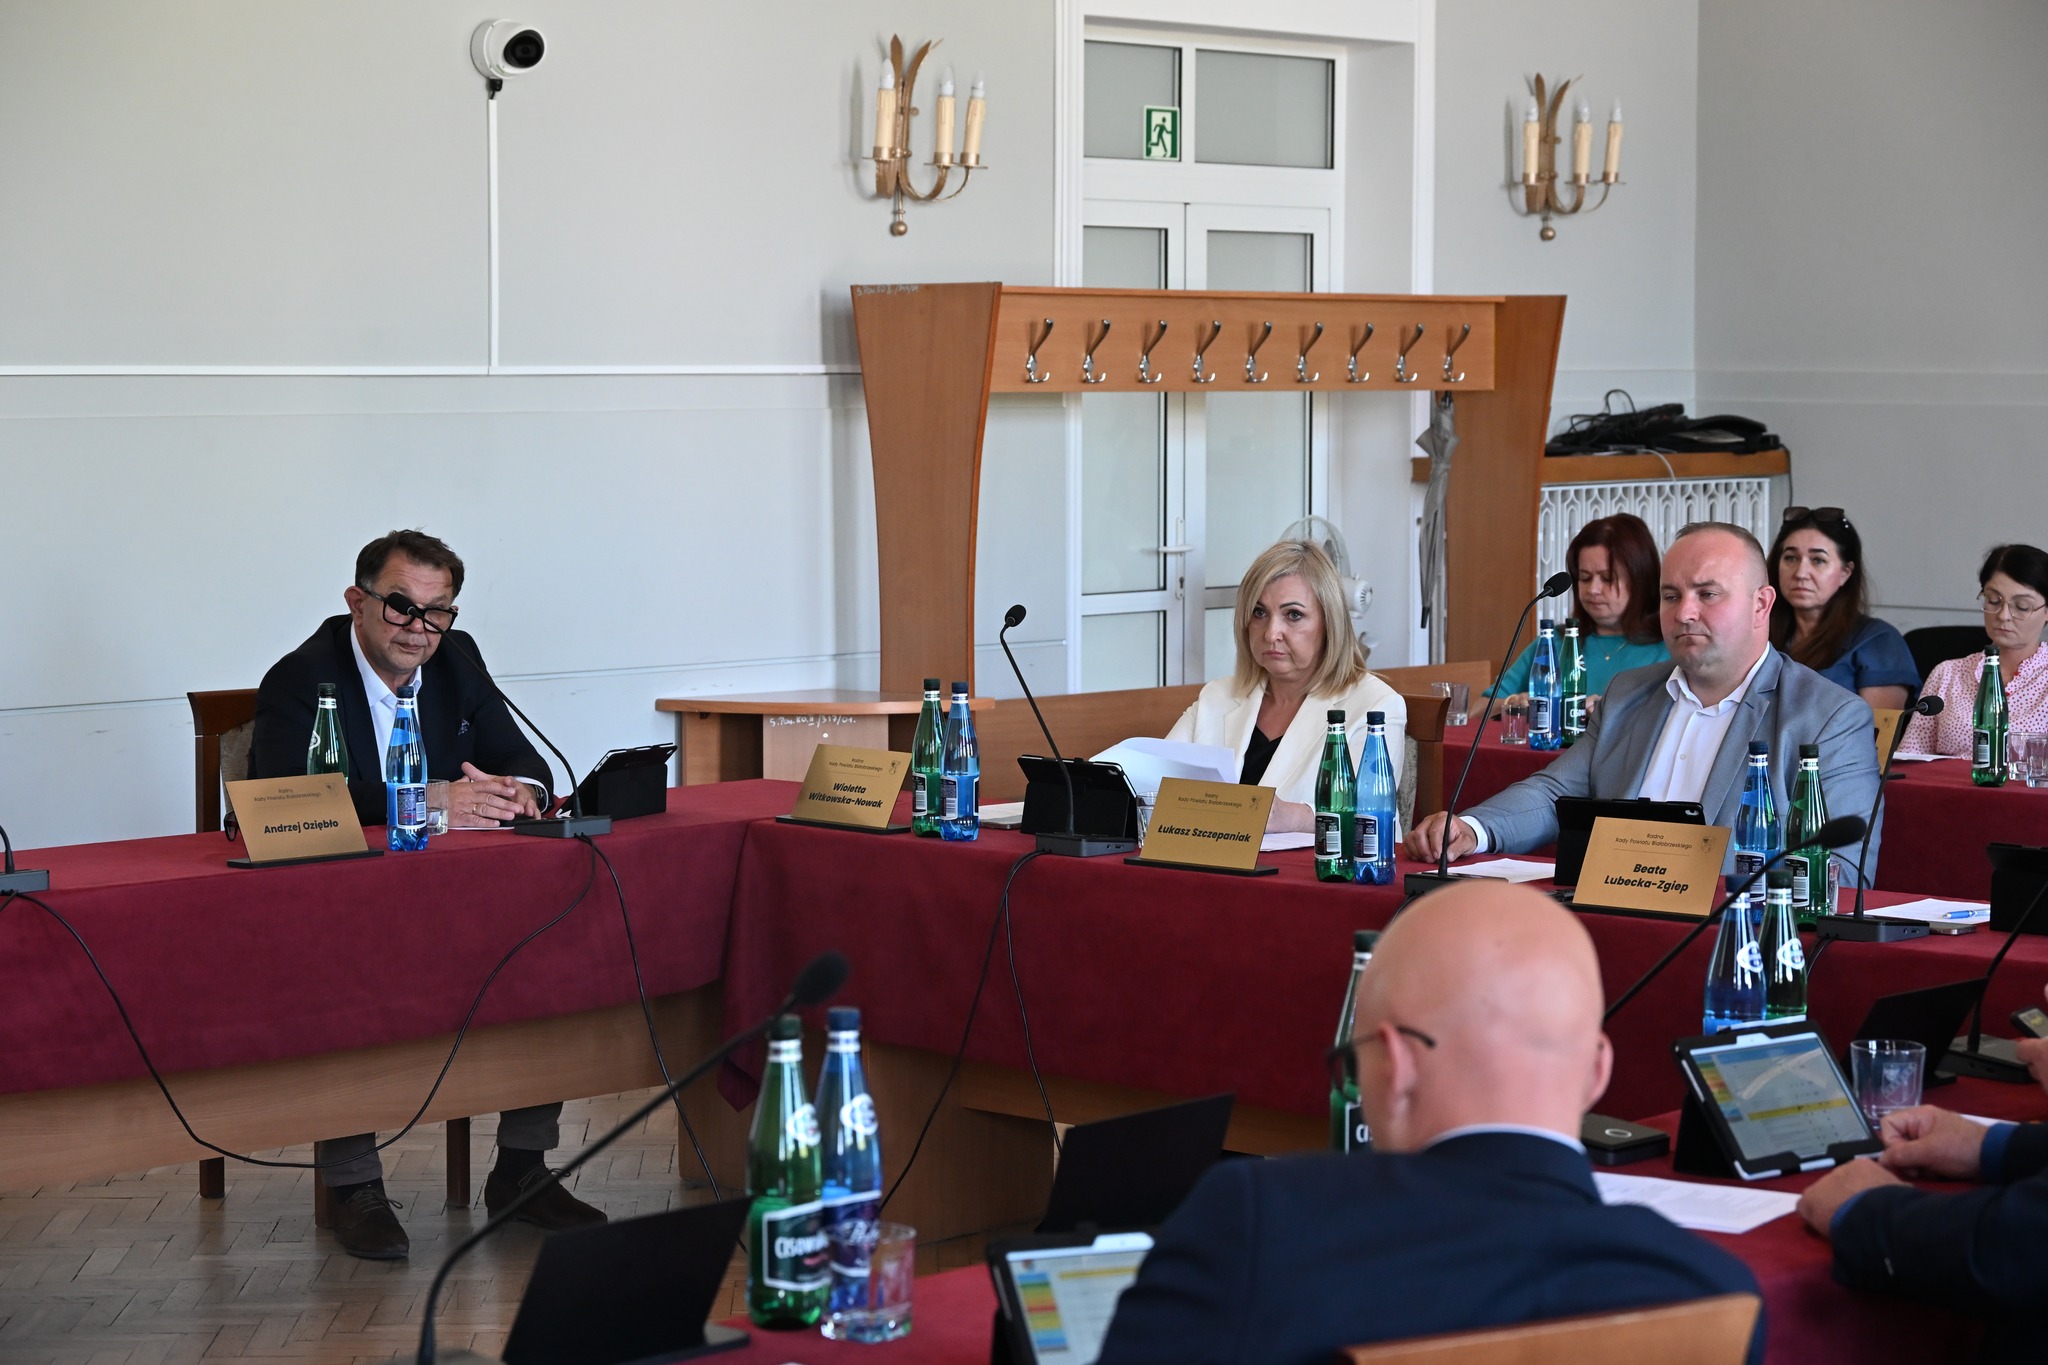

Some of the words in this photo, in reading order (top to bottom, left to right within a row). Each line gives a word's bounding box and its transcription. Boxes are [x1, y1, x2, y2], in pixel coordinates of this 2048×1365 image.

[833, 782, 867, 794] Wioletta
[808, 792, 884, 808] Witkowska-Nowak
[264, 821, 302, 834] Andrzej
[303, 819, 339, 832] Oziębło
[1157, 824, 1190, 837] Łukasz
[1191, 828, 1252, 843] Szczepaniak
[1615, 837, 1629, 845] Rady
[1629, 838, 1650, 846] Powiatu
[1633, 863, 1668, 875] Beata
[1604, 875, 1689, 894] Lubecka-Zgiep
